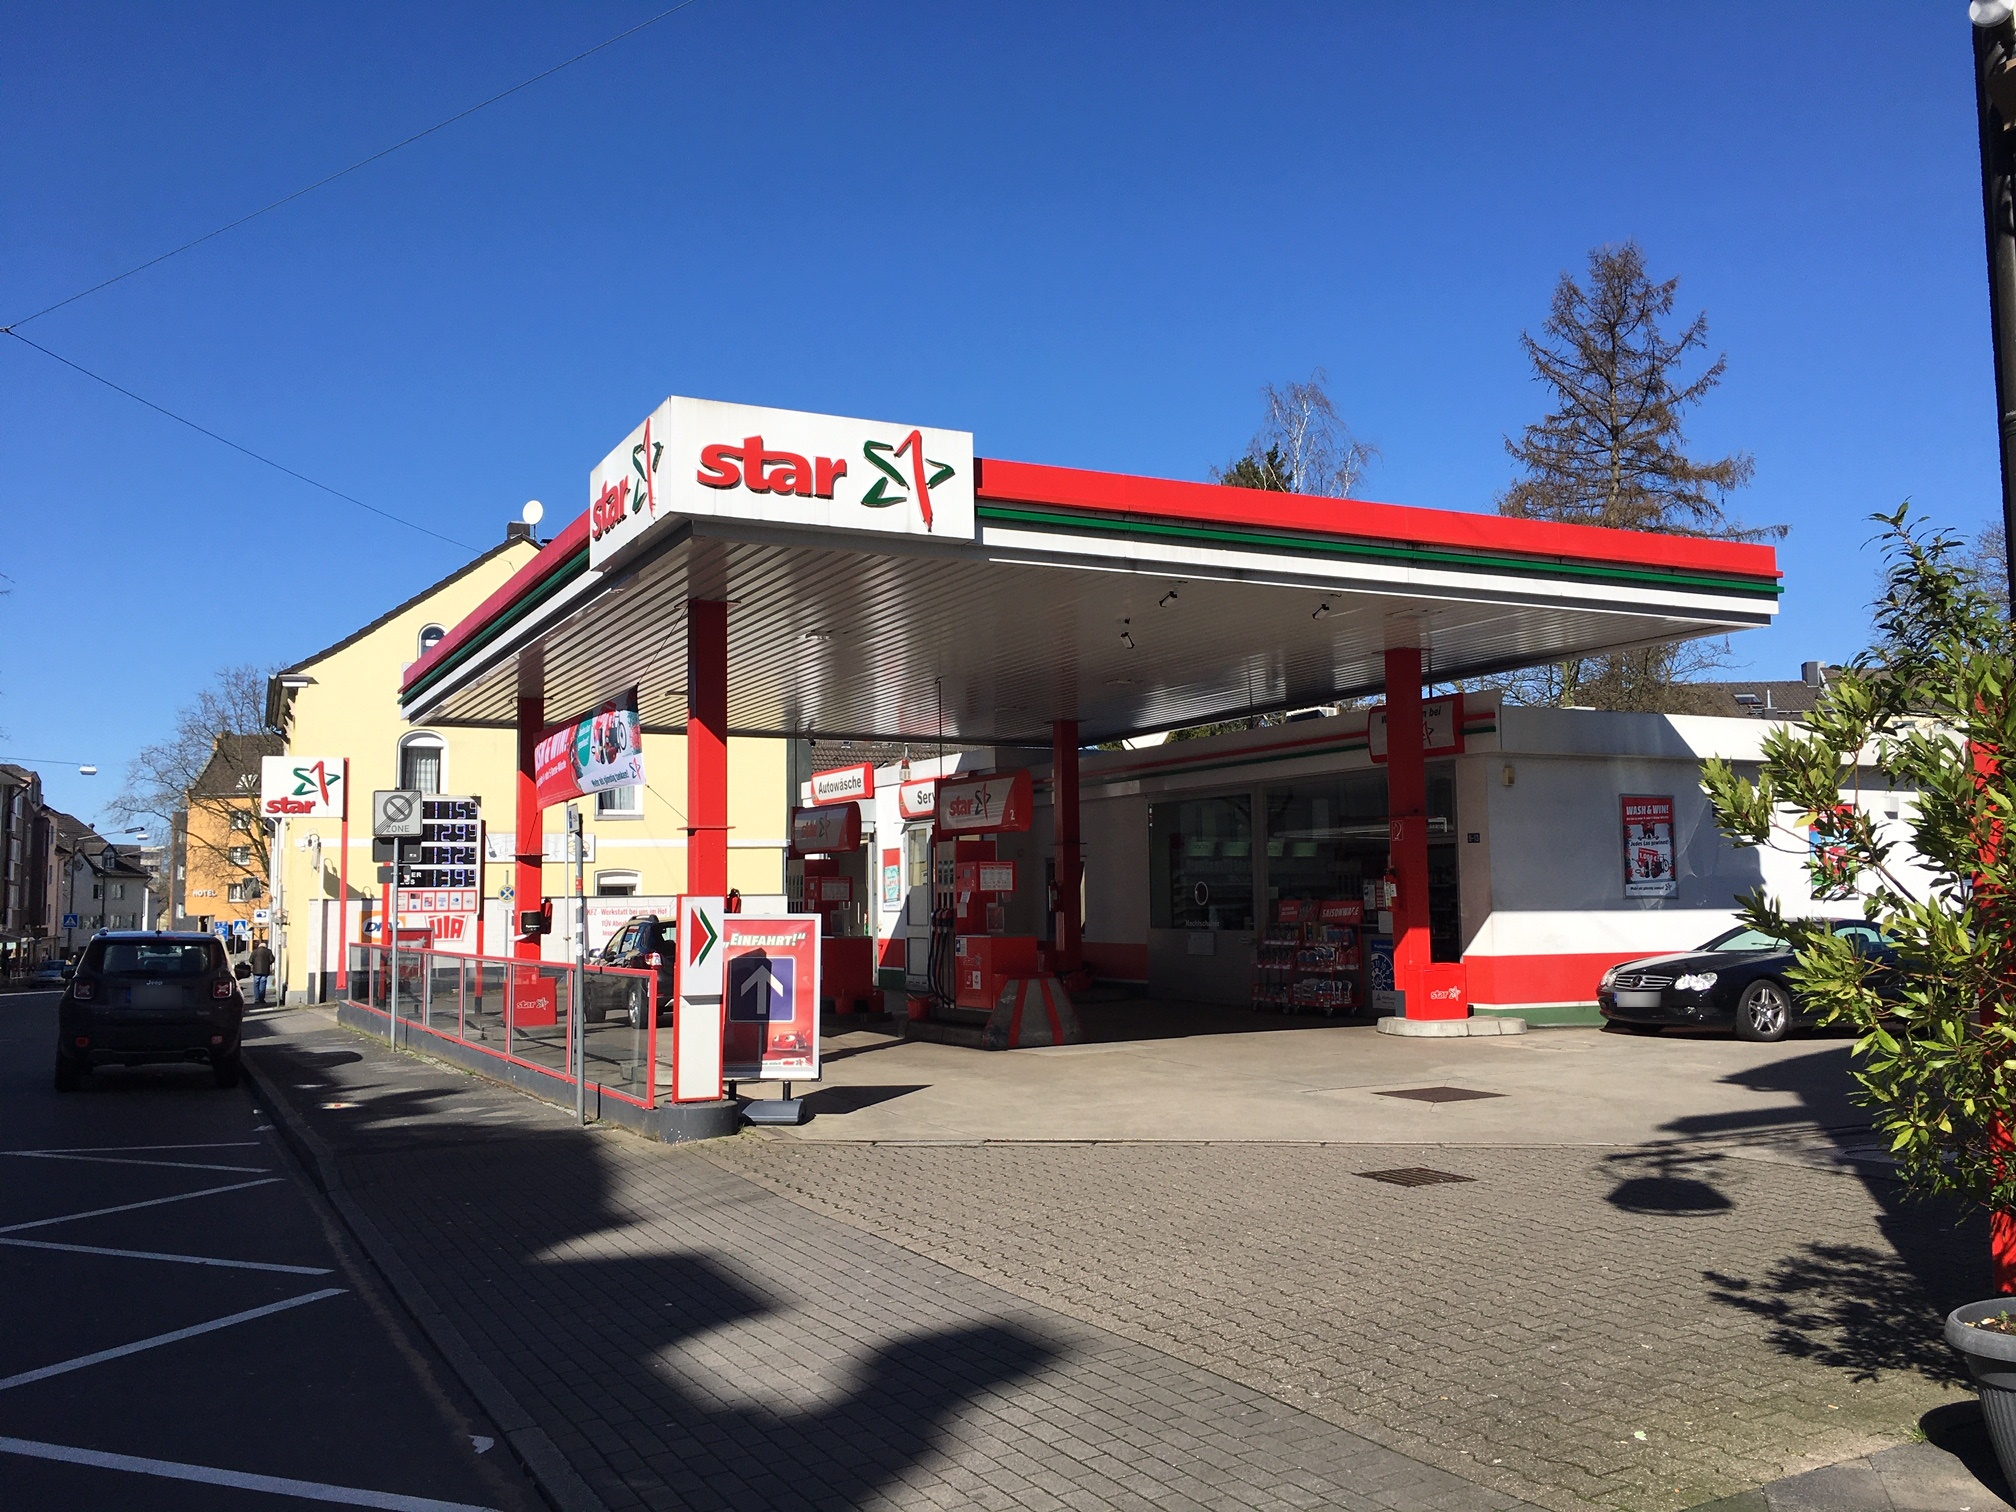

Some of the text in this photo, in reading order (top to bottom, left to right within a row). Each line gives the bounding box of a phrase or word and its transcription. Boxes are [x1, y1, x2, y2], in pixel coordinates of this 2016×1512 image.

[697, 435, 847, 499] star
[592, 475, 630, 542] star
[1429, 706, 1442, 717] bei
[818, 776, 862, 796] Autowäsche
[917, 790, 935, 806] Serv
[265, 796, 316, 814] star
[950, 795, 1015, 821] star 2
[1626, 804, 1669, 815] WASH & WIN!
[386, 825, 410, 833] ZONE
[192, 889, 217, 897] HOTEL
[1430, 990, 1448, 1000] star
[516, 1000, 536, 1009] star
